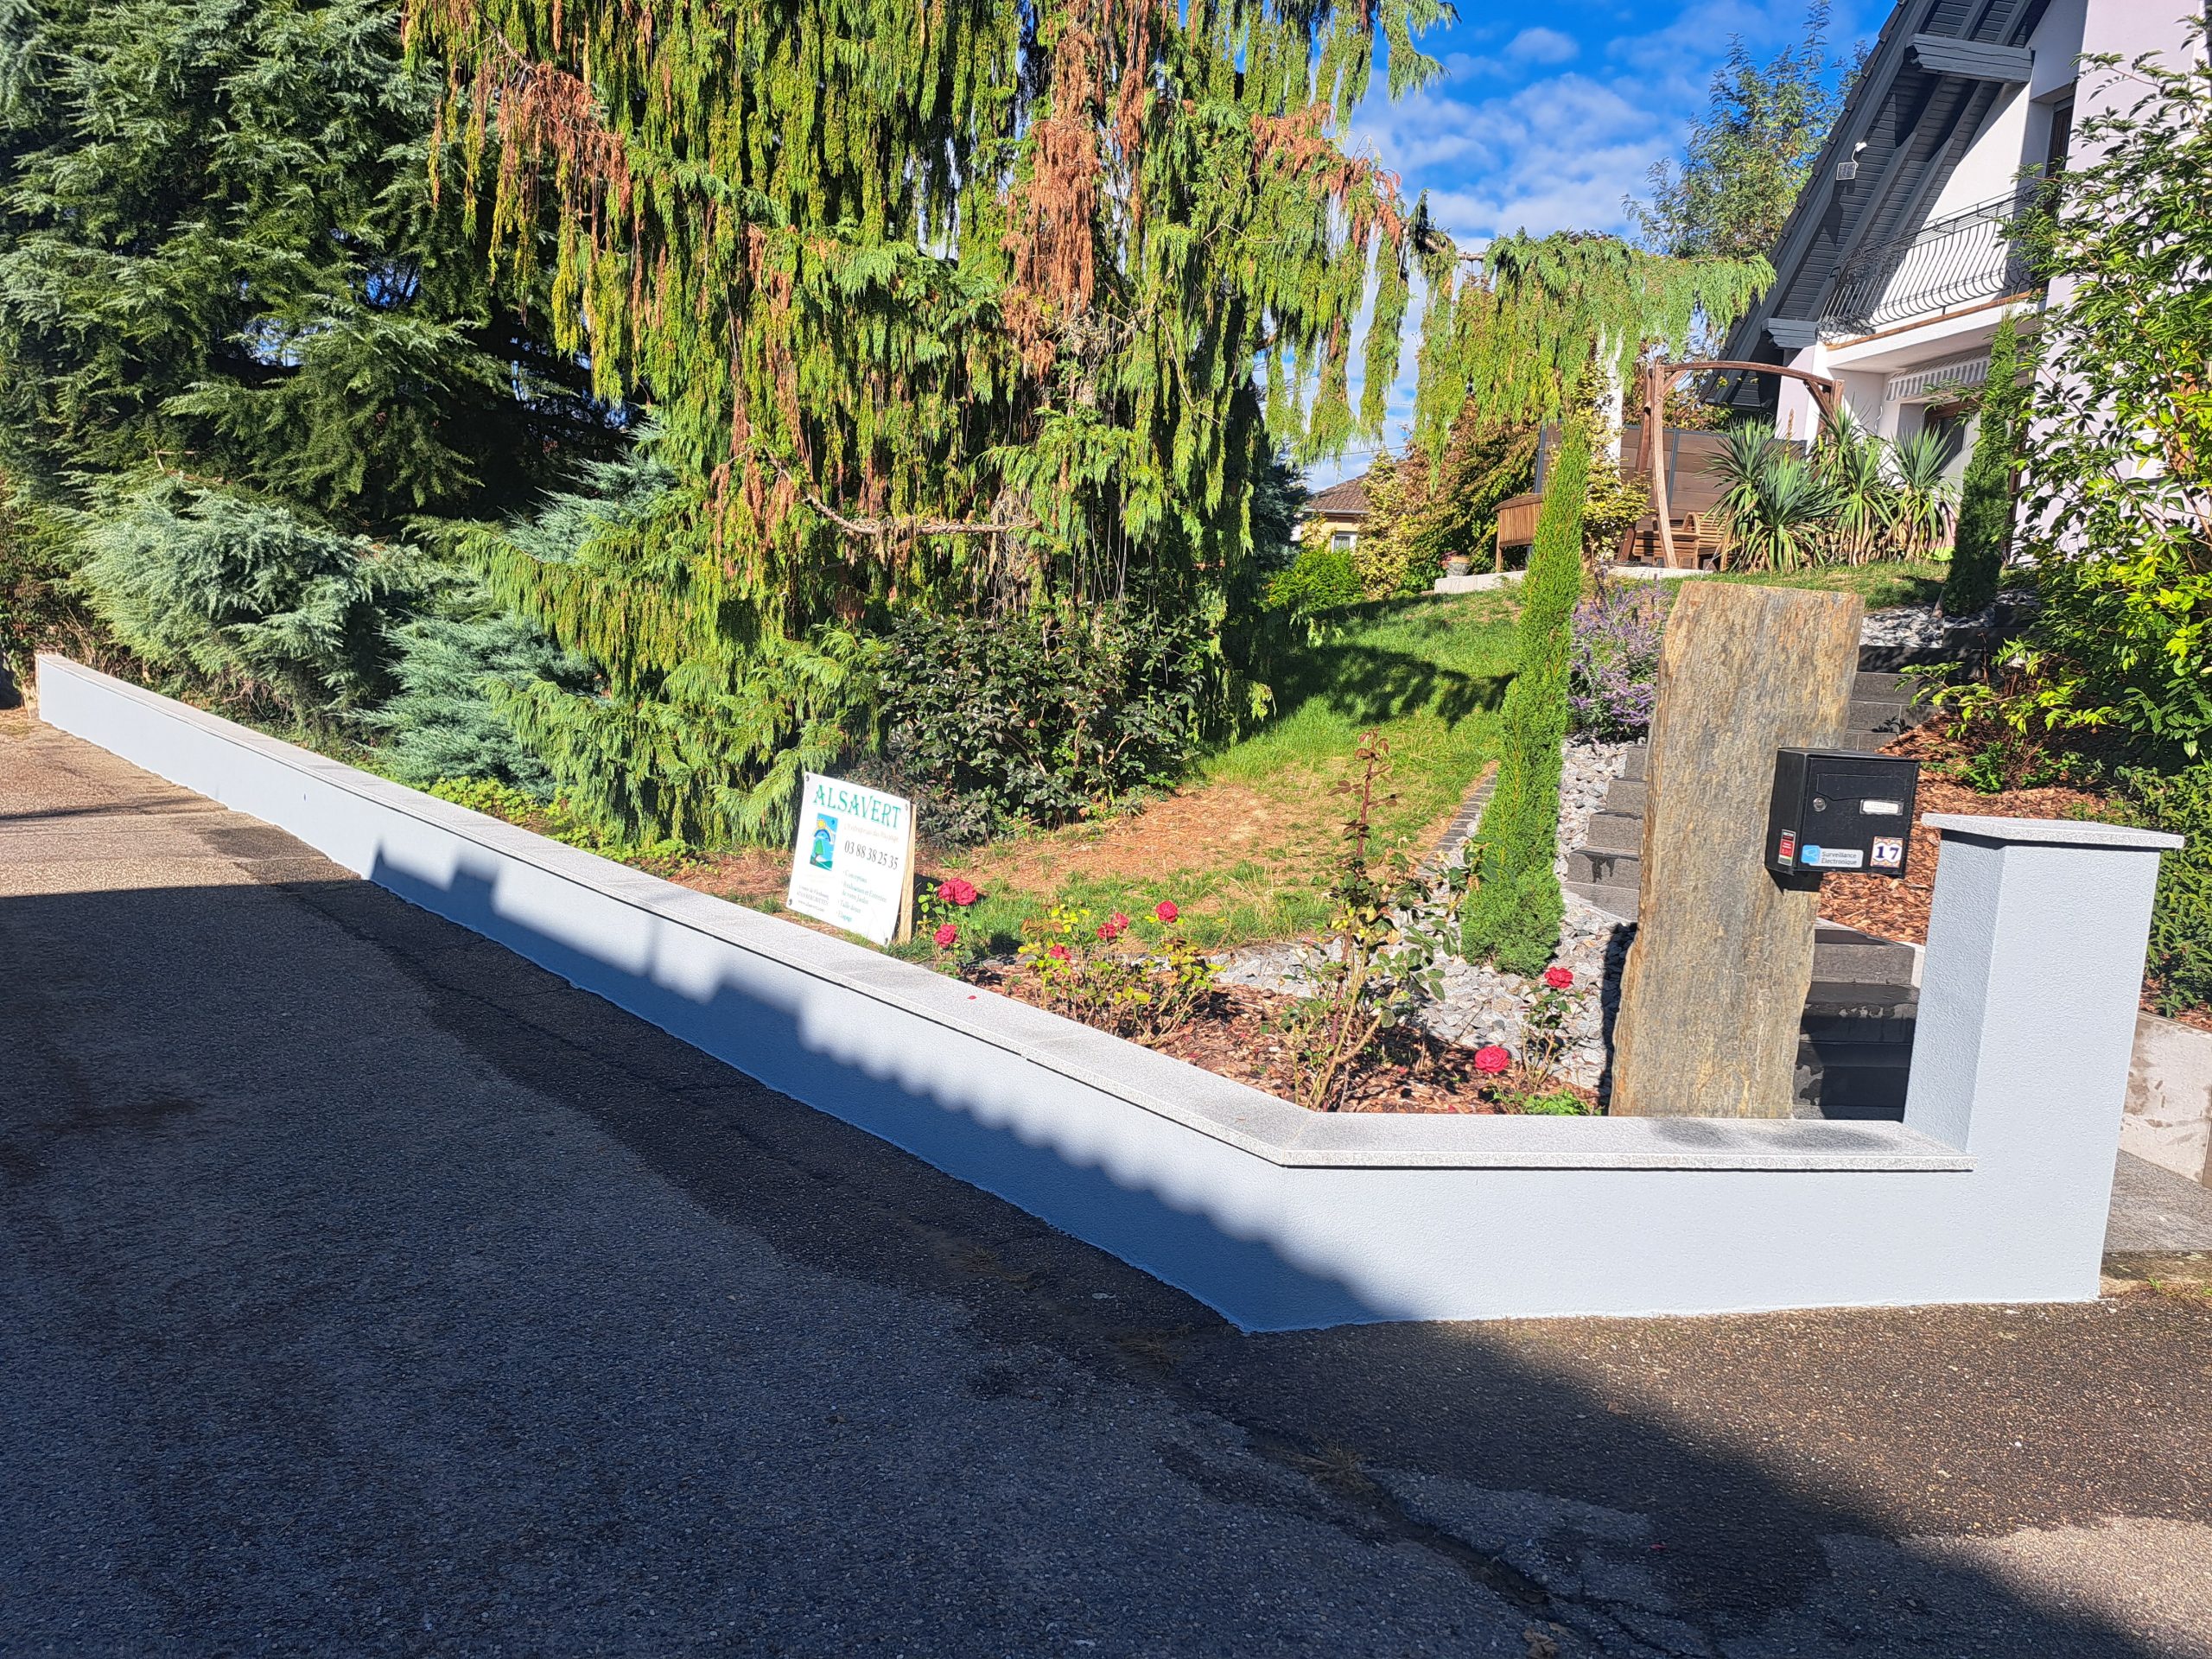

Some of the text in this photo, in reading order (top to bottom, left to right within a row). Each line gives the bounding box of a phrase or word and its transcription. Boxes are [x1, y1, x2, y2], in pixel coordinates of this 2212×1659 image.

[813, 784, 901, 830] ALSAVERT
[844, 840, 899, 870] 03 88 38 25 35
[1876, 846, 1900, 860] 17
